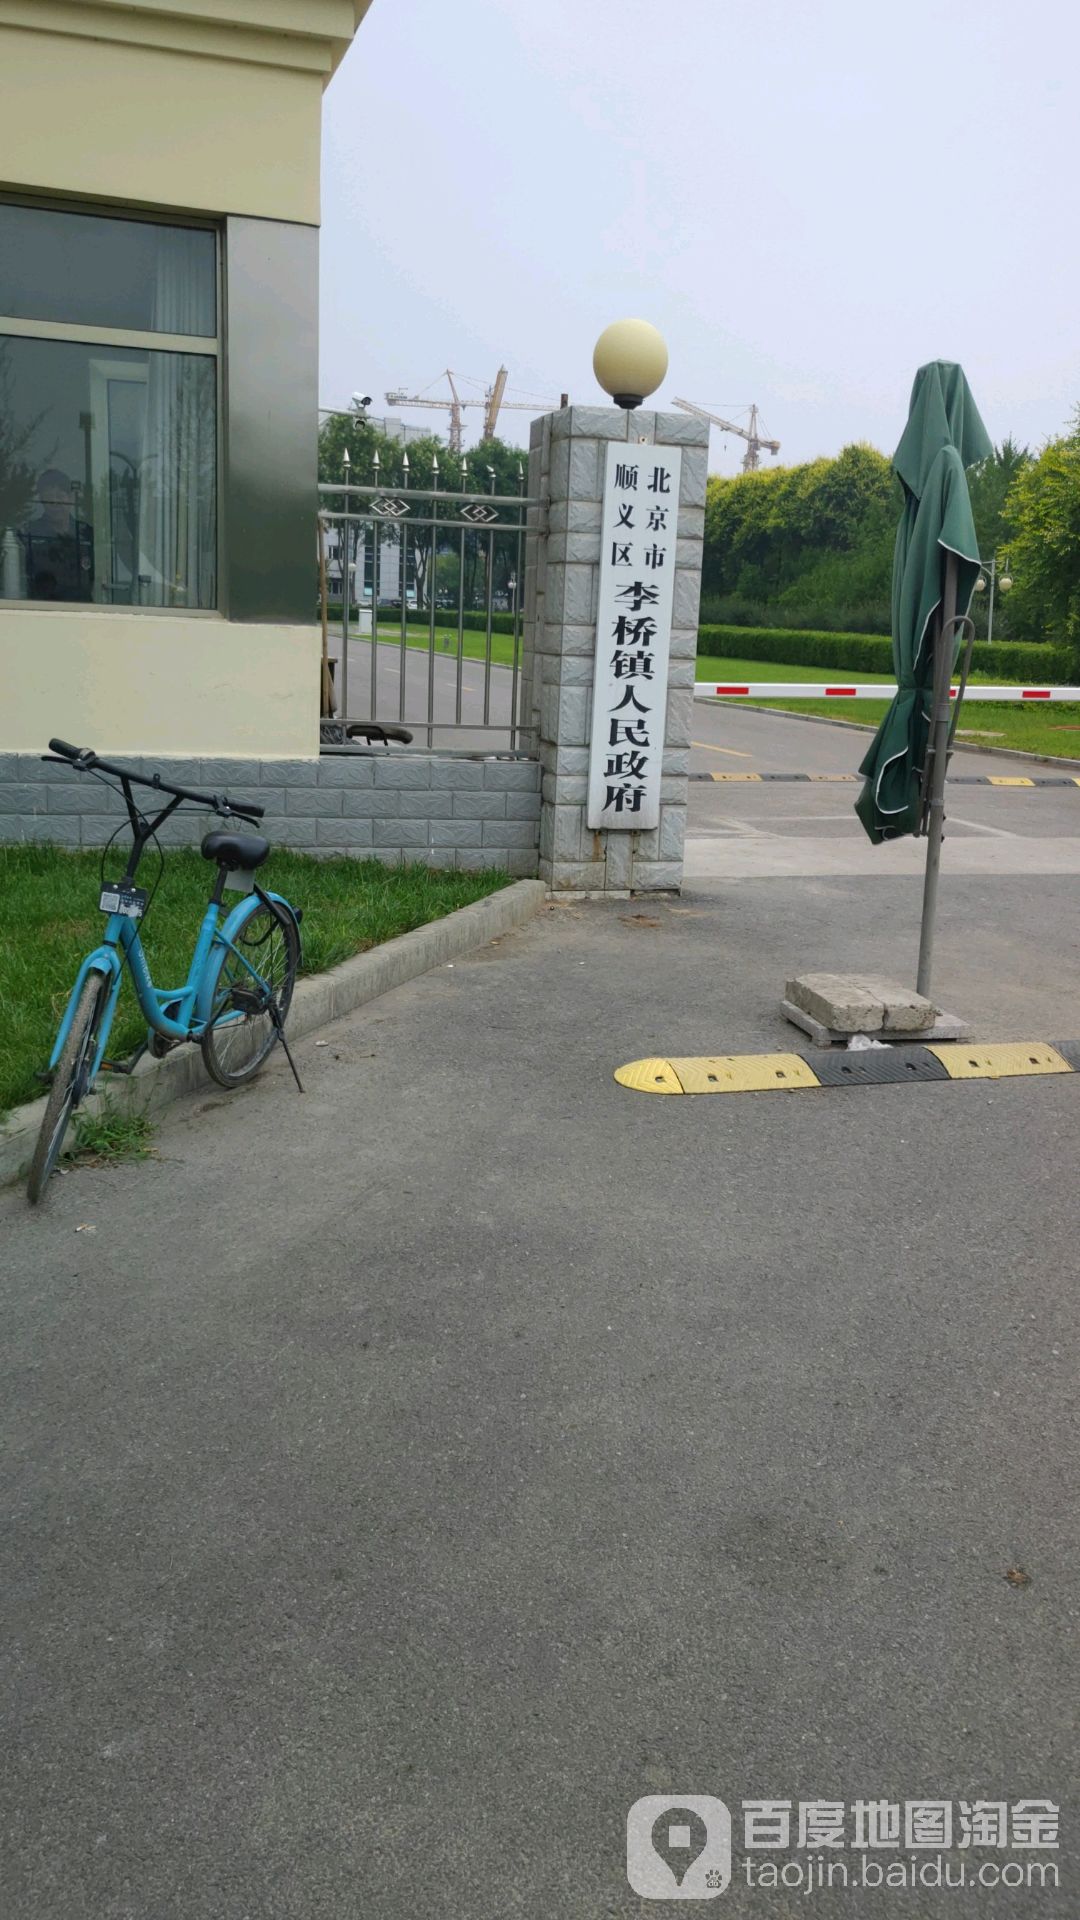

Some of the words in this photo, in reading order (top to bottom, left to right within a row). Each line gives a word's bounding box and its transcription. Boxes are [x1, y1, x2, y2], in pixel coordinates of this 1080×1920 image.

[611, 463, 640, 567] 顺义区
[643, 466, 671, 570] 北京市
[601, 581, 660, 813] 李桥镇人民政府
